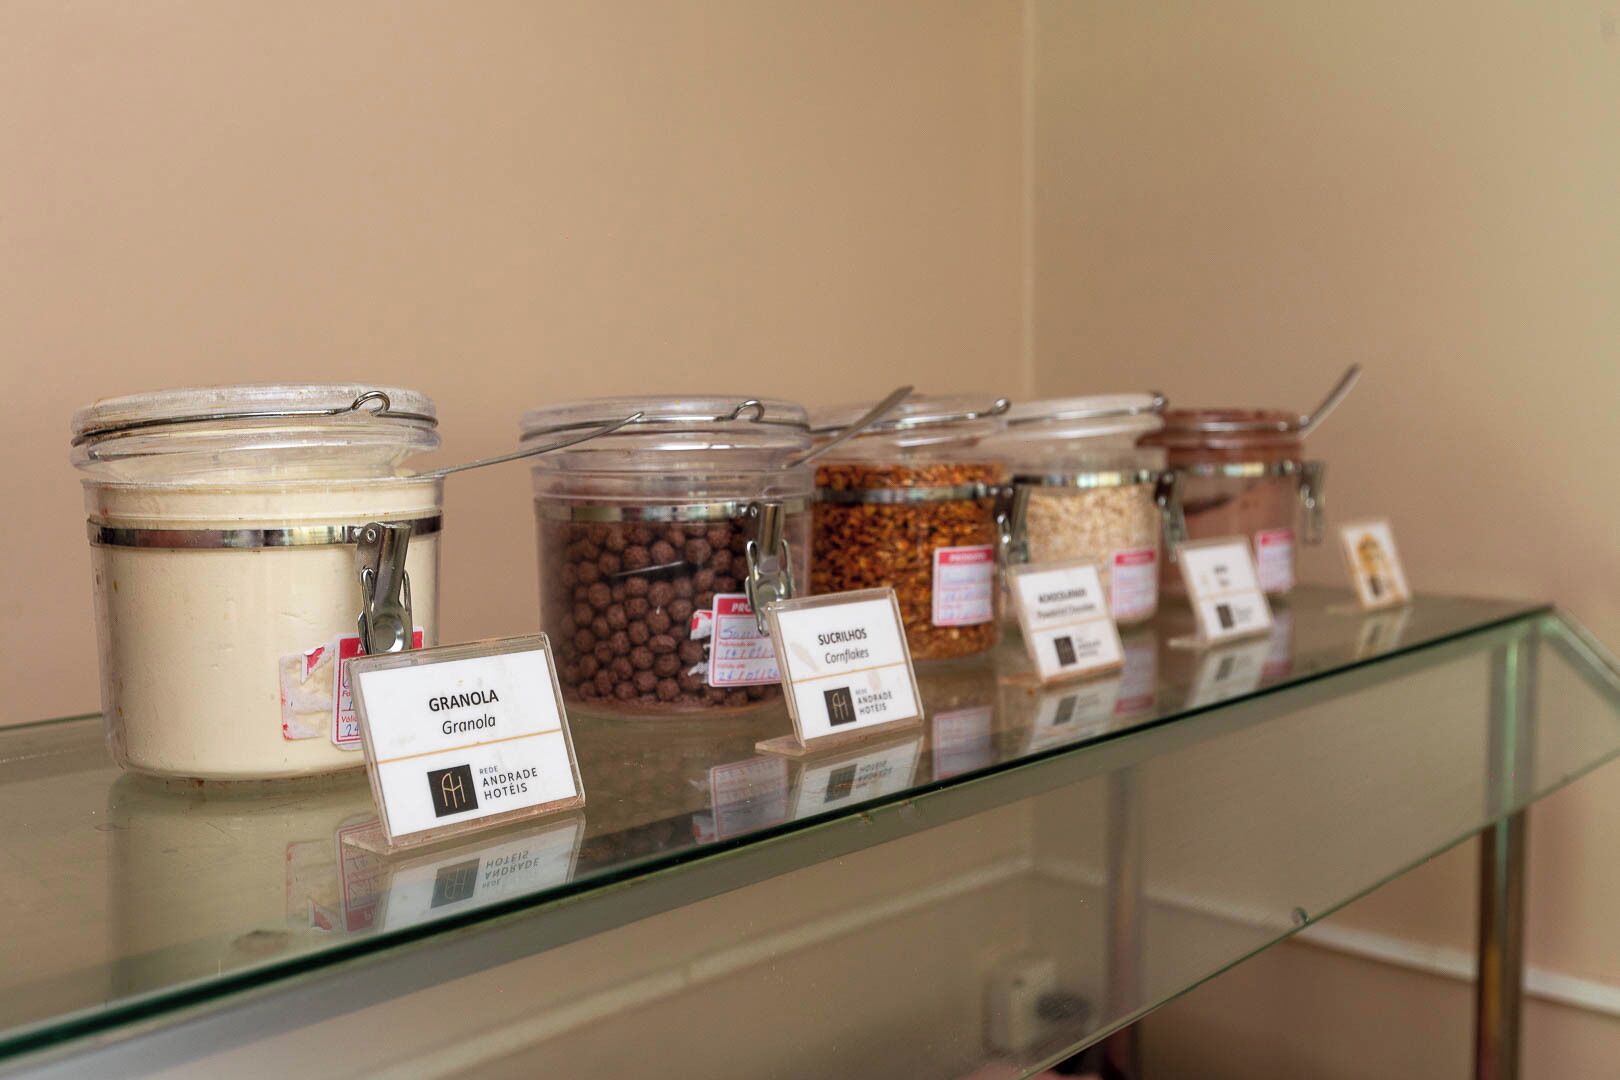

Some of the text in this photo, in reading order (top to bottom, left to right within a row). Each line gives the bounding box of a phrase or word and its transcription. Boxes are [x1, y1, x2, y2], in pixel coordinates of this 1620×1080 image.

[818, 628, 867, 646] SUCRILHOS
[825, 648, 869, 664] Cornflakes
[428, 689, 499, 712] GRANOLA
[857, 691, 893, 705] ANDRADE
[442, 713, 496, 735] Granola
[479, 766, 498, 774] REDE
[482, 767, 538, 787] ANDRADE
[484, 782, 528, 800] HOTÉIS
